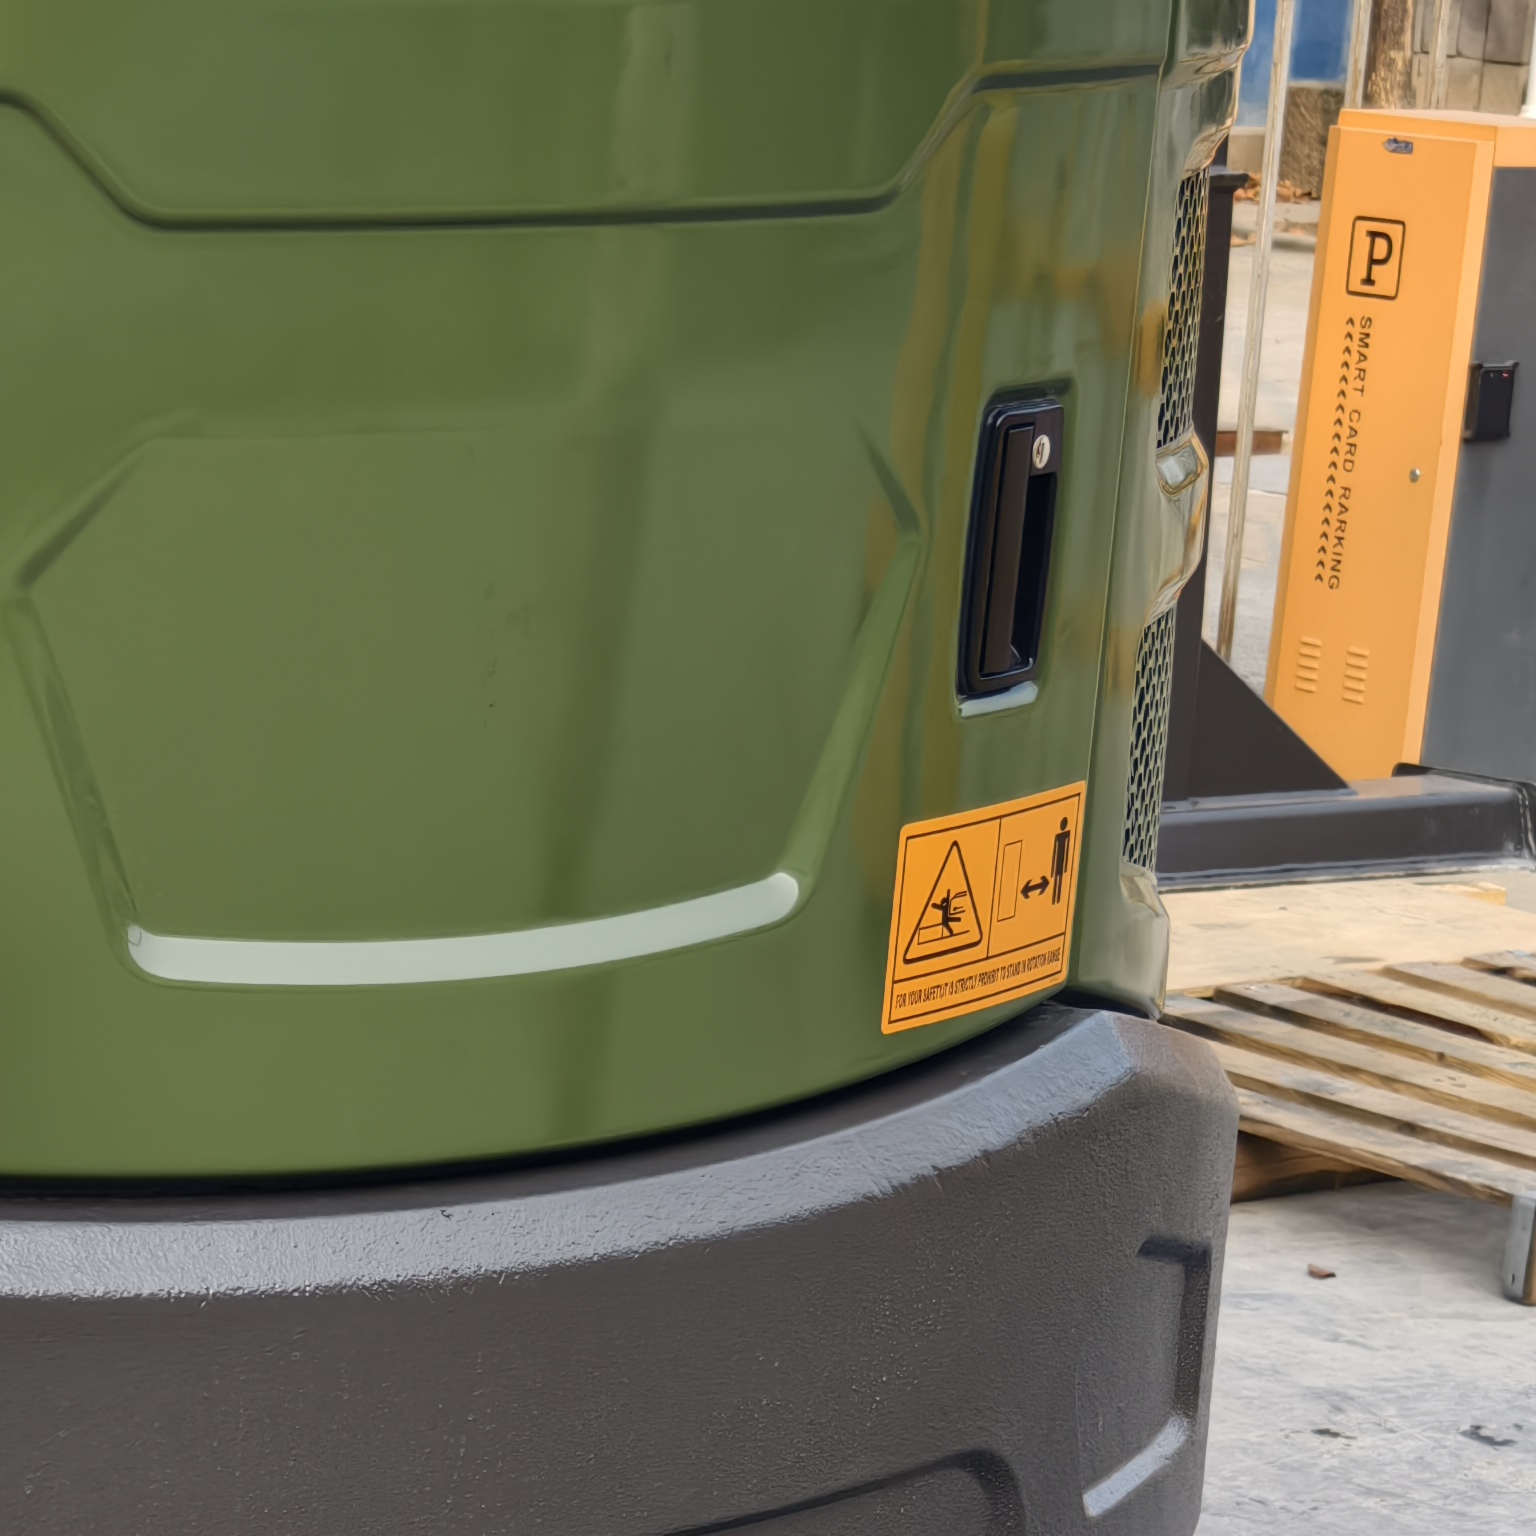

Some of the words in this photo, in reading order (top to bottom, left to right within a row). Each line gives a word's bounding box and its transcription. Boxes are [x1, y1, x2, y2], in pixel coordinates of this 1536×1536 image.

[1360, 230, 1393, 286] P
[1352, 315, 1373, 397] SMART
[1342, 409, 1361, 473] CARD
[1327, 485, 1352, 590] RARKING
[895, 993, 906, 1009] FOR
[1006, 962, 1021, 979] STAND
